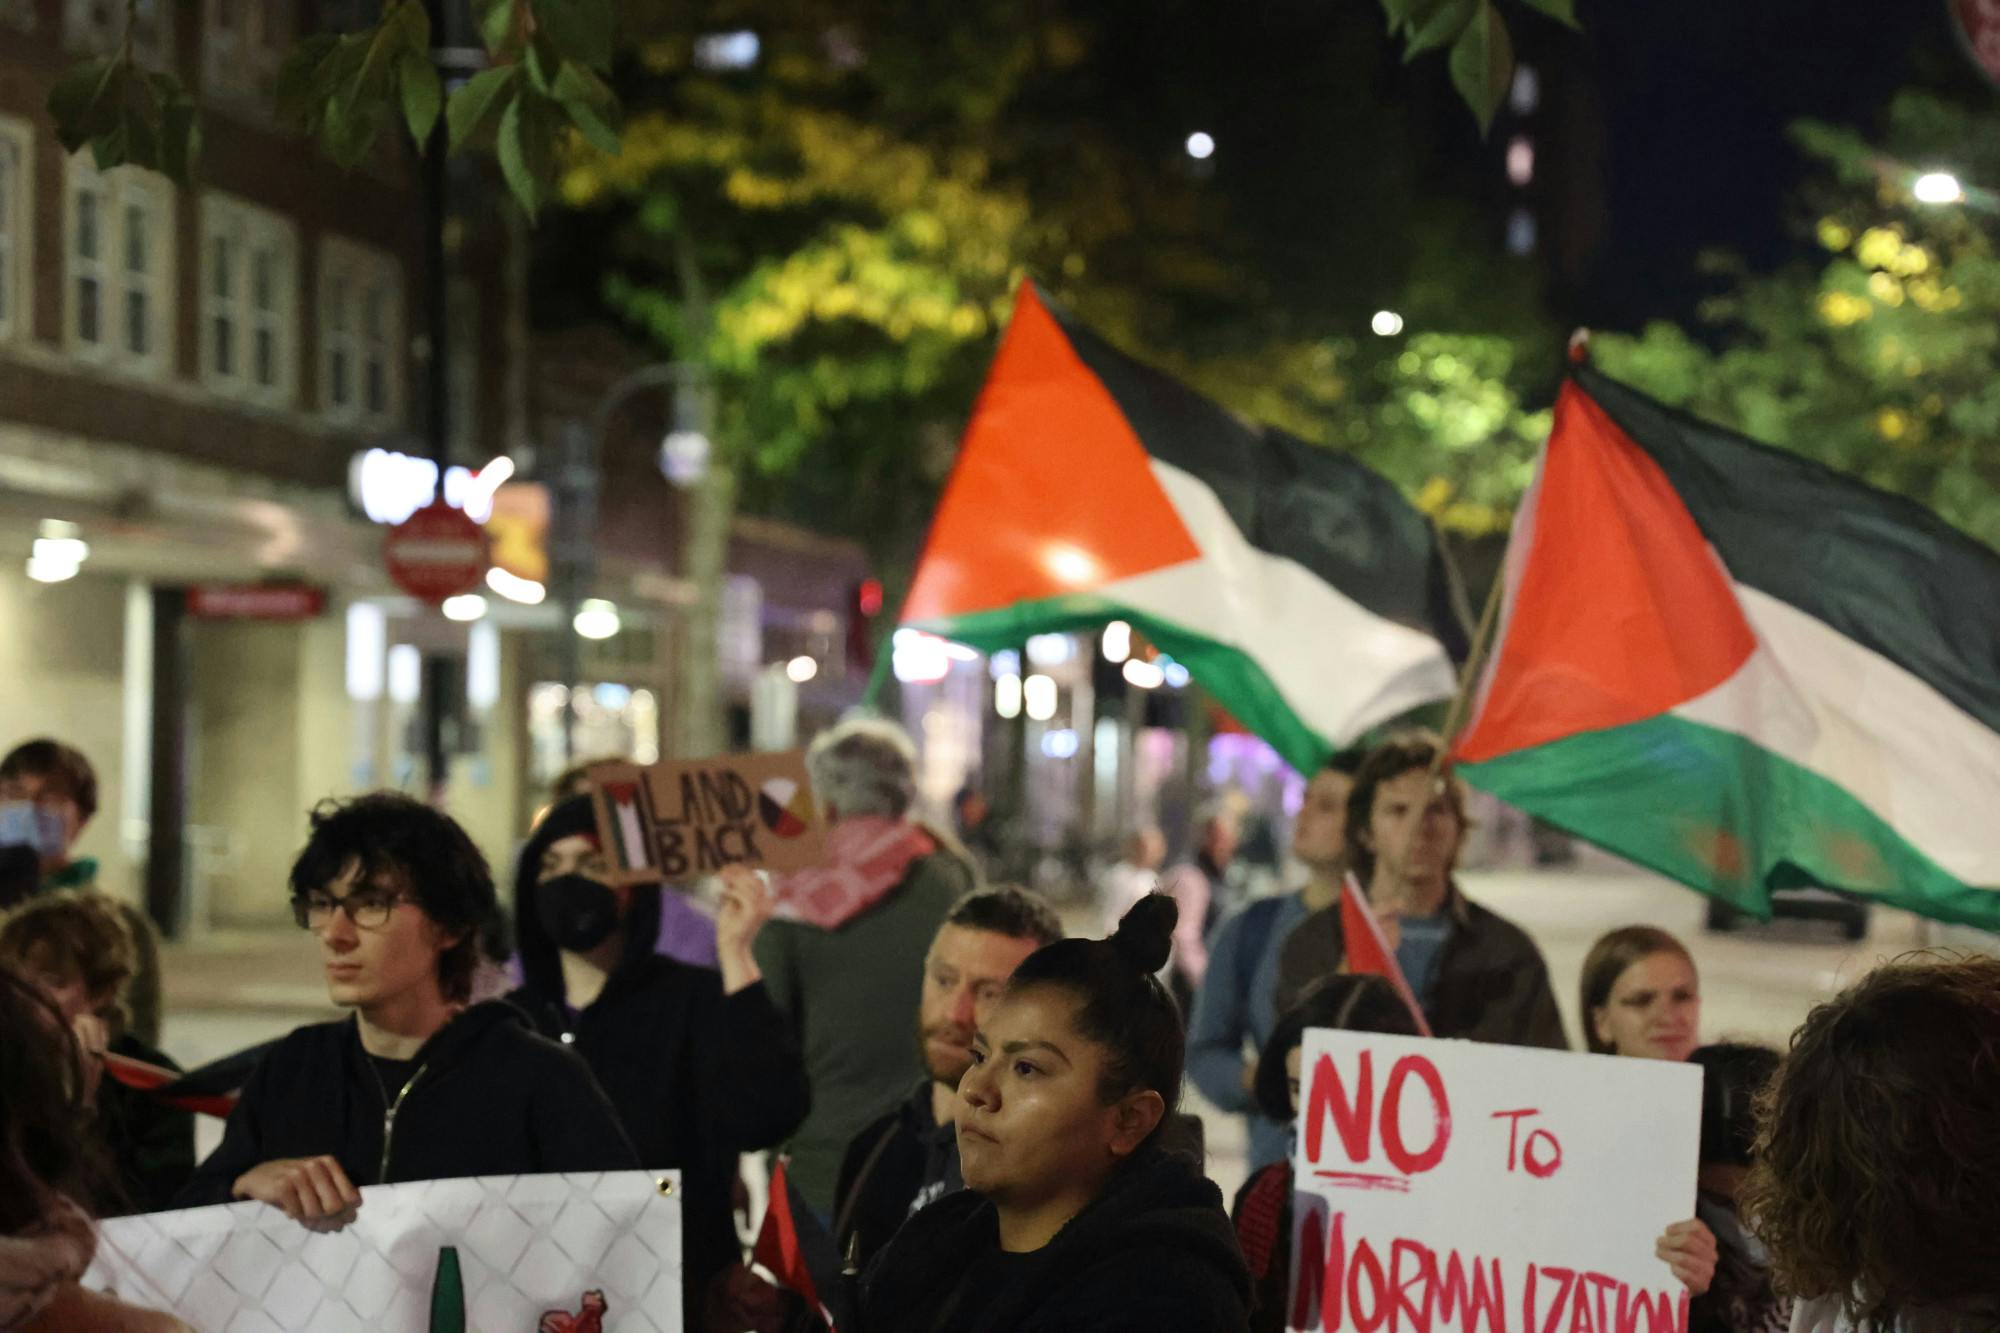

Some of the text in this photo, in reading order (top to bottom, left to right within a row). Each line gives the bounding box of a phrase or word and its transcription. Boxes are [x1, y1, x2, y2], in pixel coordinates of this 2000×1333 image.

[641, 770, 753, 826] LAND
[656, 824, 764, 876] BACK
[1305, 1049, 1451, 1175] NO
